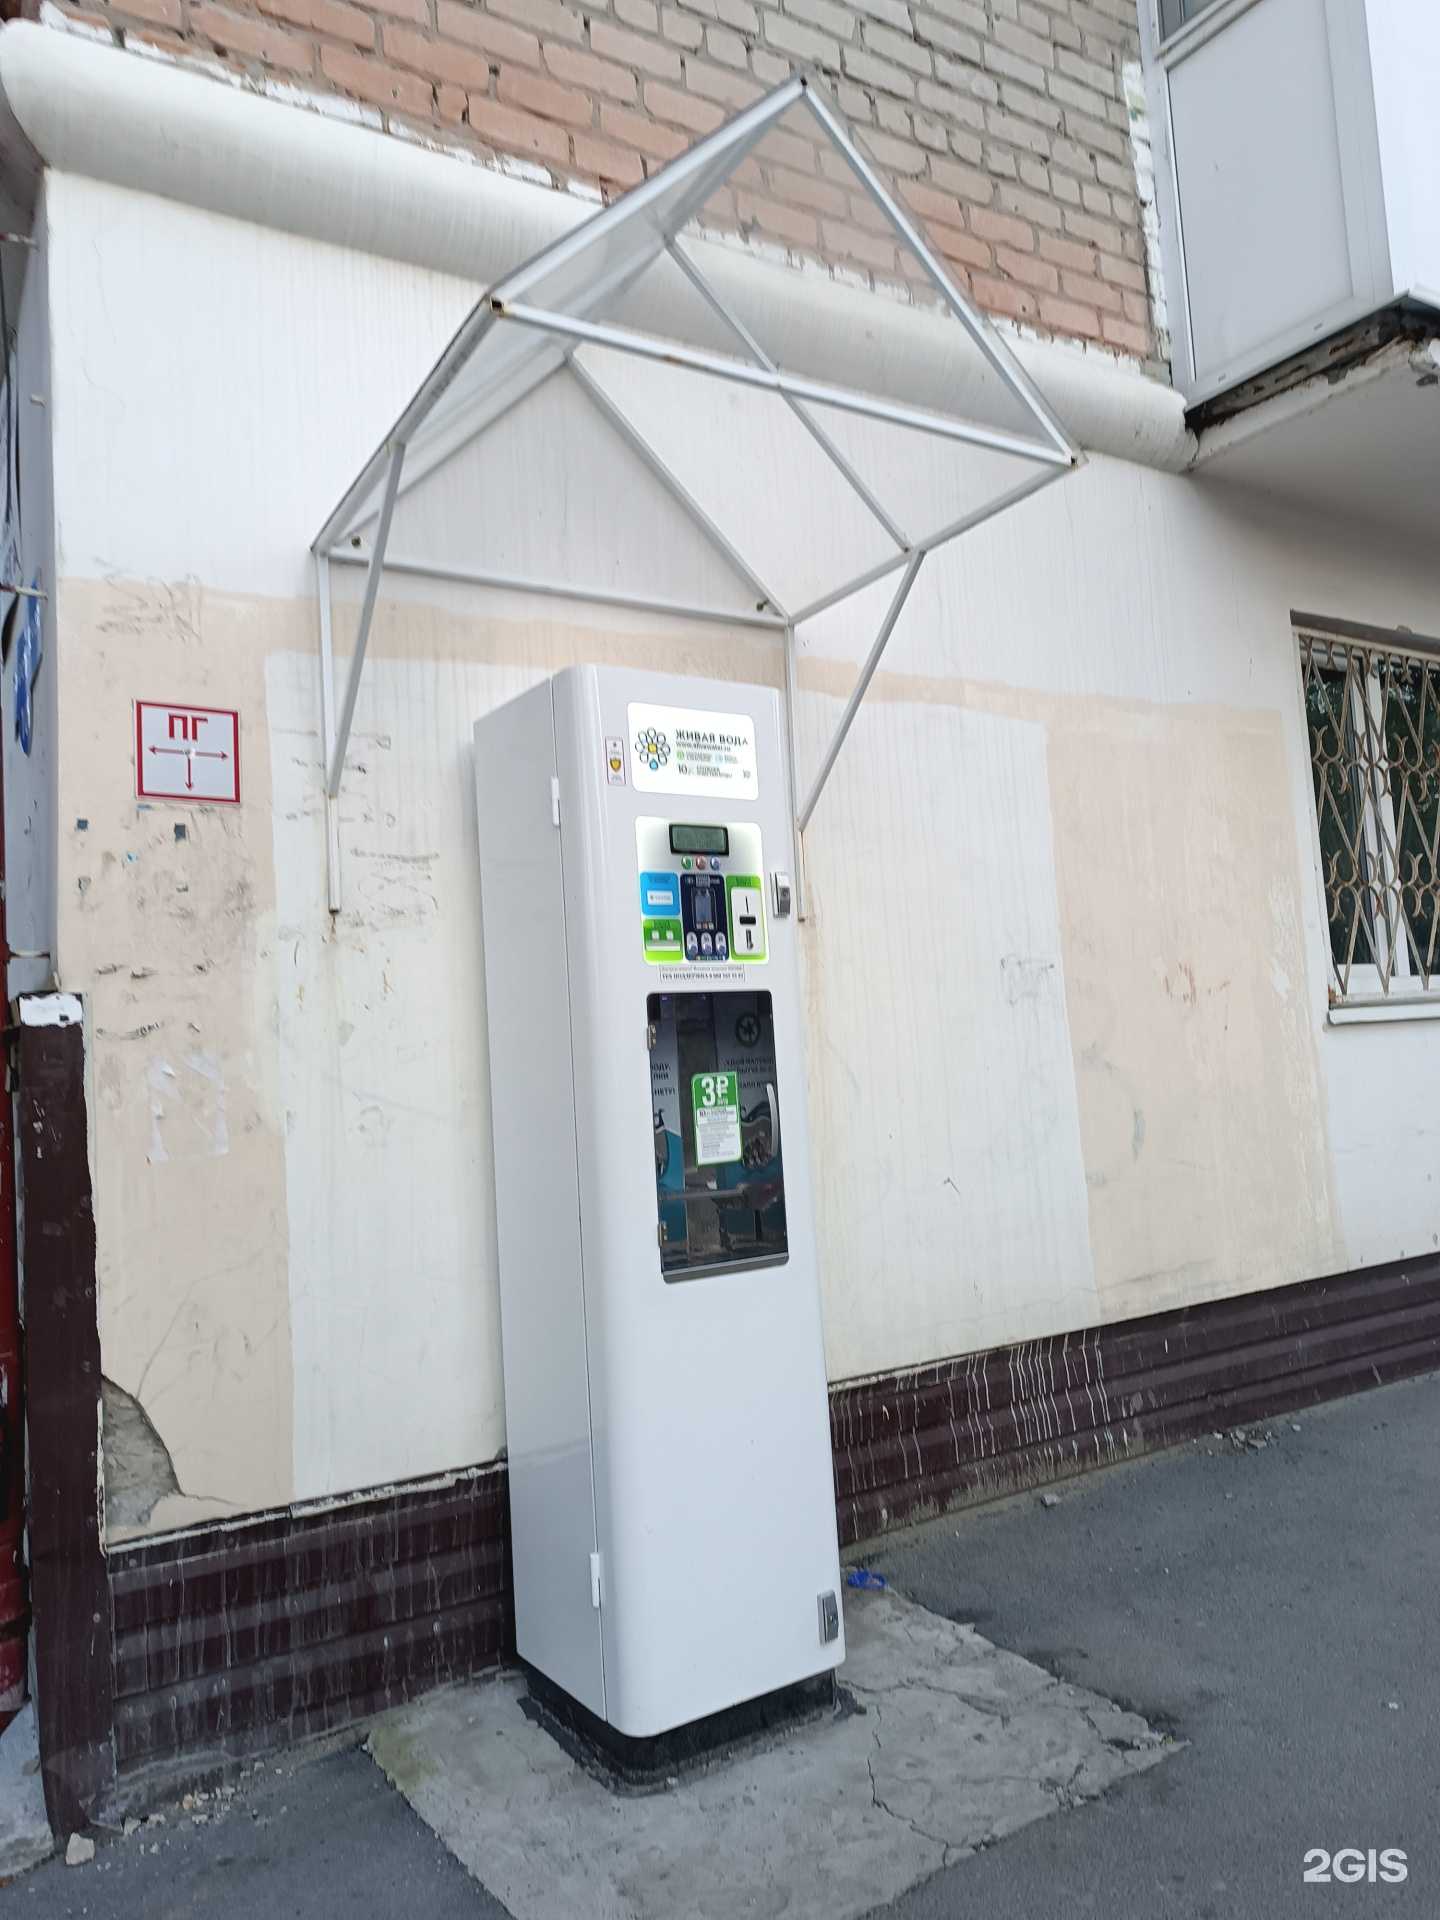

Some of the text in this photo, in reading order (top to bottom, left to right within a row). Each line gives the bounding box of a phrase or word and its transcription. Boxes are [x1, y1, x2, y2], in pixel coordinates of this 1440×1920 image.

[168, 714, 208, 740] ПГ
[675, 728, 749, 747] ЖИВАЯ ВОДА
